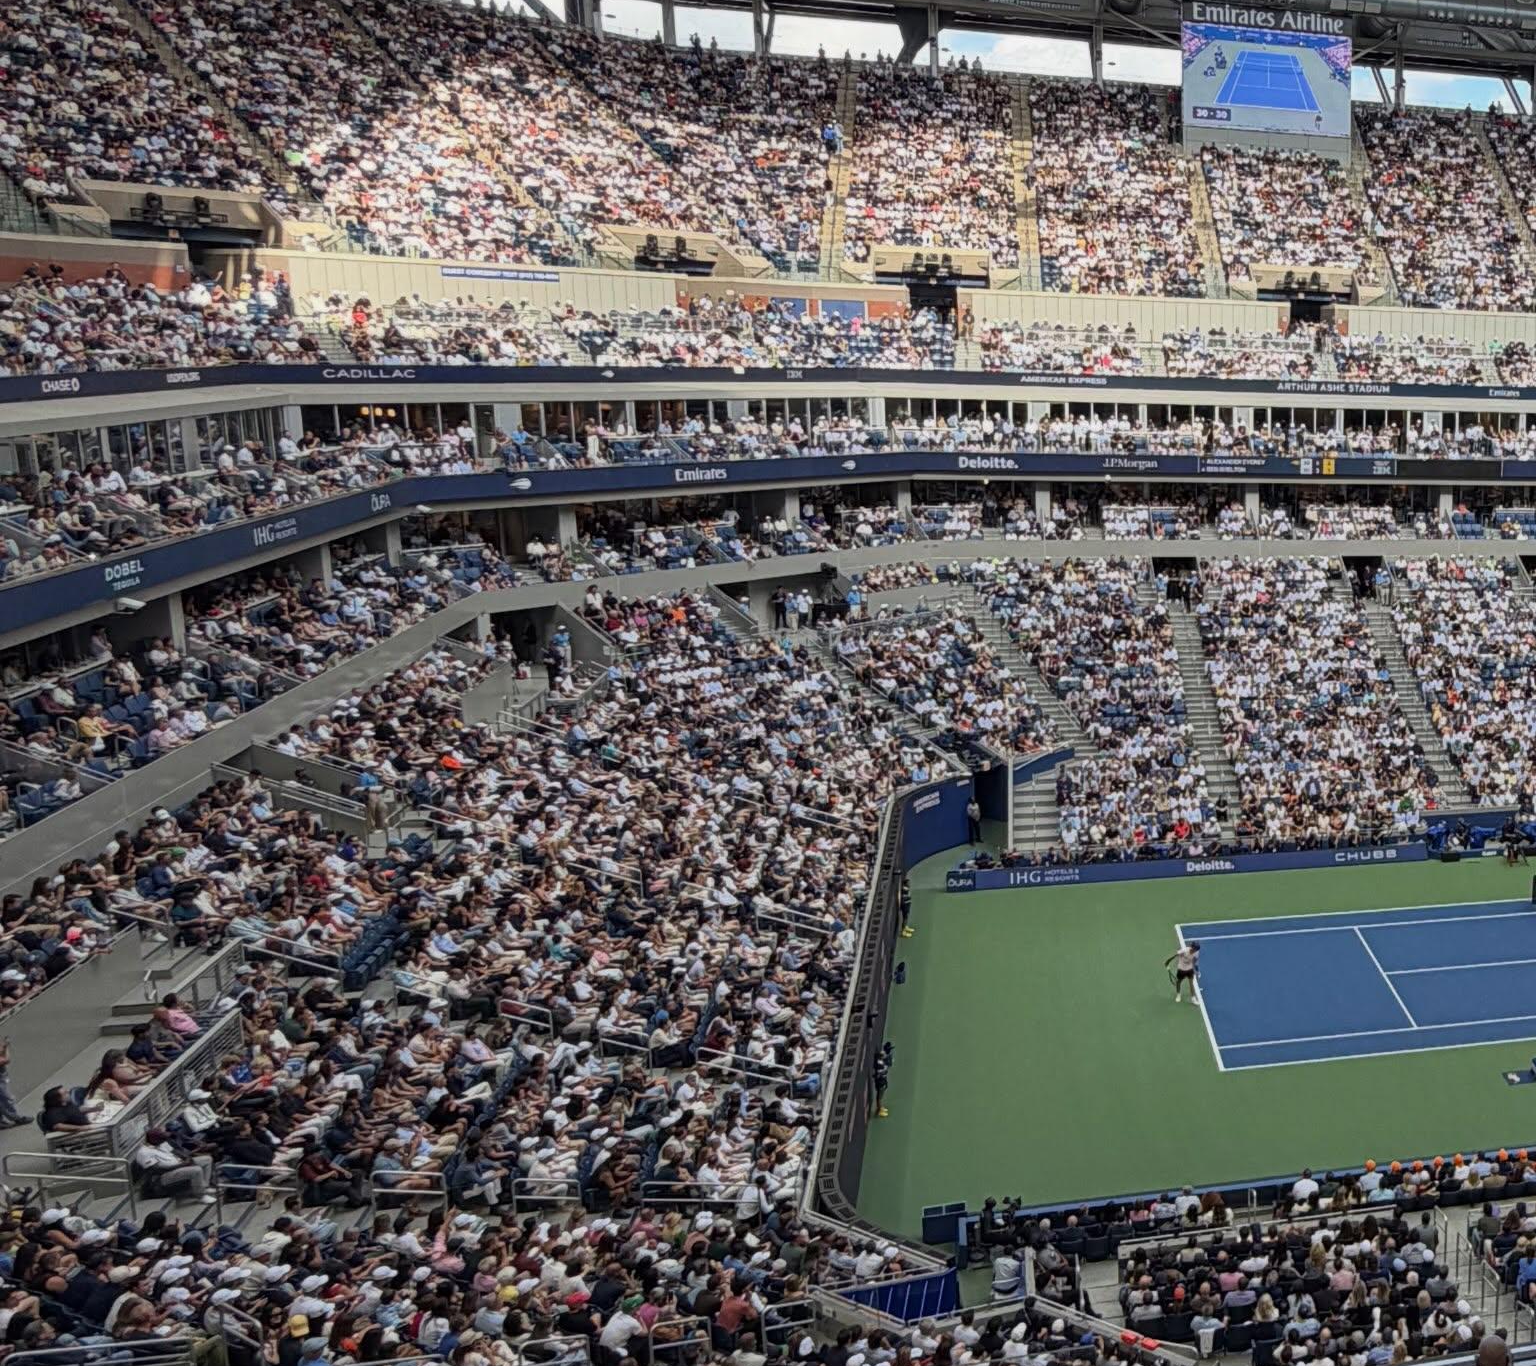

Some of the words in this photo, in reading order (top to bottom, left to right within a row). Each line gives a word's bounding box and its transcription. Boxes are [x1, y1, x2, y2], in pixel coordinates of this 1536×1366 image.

[1192, 1, 1275, 27] Emirates
[1281, 10, 1344, 34] Airline
[322, 368, 416, 379] CADILLAC
[1020, 375, 1066, 384] AMERICAN
[1068, 377, 1107, 385] EXPRESS
[42, 379, 72, 393] CHASE
[1277, 382, 1318, 392] ARTHUR
[1320, 383, 1346, 393] ASHE
[1349, 385, 1391, 394] STADIUM
[958, 456, 1019, 469] Deloitte.
[674, 466, 728, 482] Emirates
[253, 523, 275, 546] IHG
[105, 559, 144, 581] DOBEL
[1335, 849, 1398, 861] CHUBB
[1186, 860, 1235, 872] Deloitte.
[1009, 871, 1041, 884] IHG
